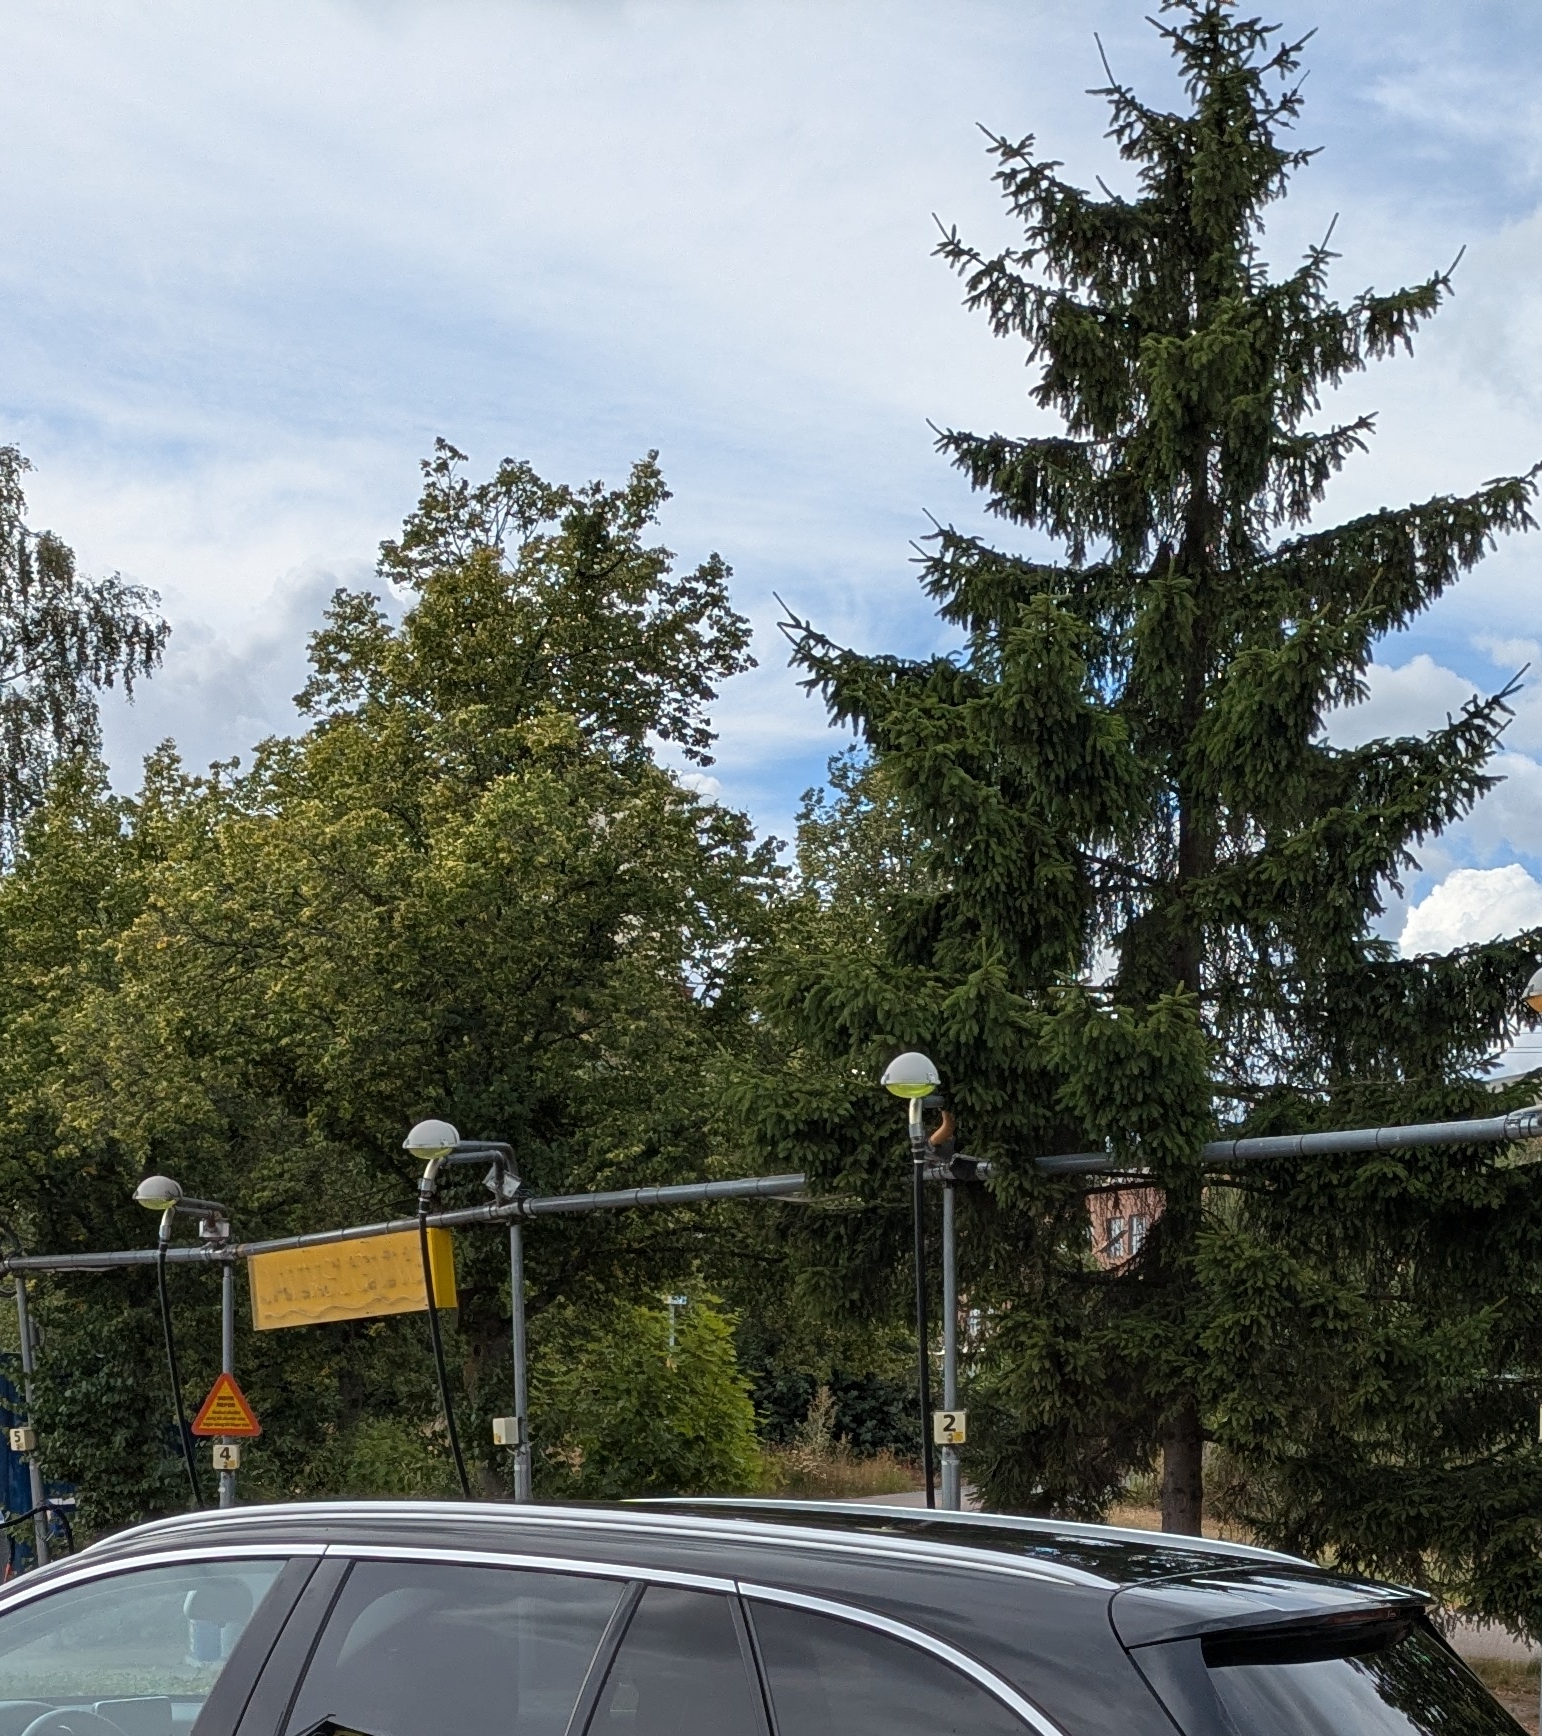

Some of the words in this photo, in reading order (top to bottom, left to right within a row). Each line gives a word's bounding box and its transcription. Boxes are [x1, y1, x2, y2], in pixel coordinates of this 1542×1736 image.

[943, 1414, 957, 1432] 2
[14, 1430, 21, 1443] 5
[220, 1446, 232, 1461] 4
